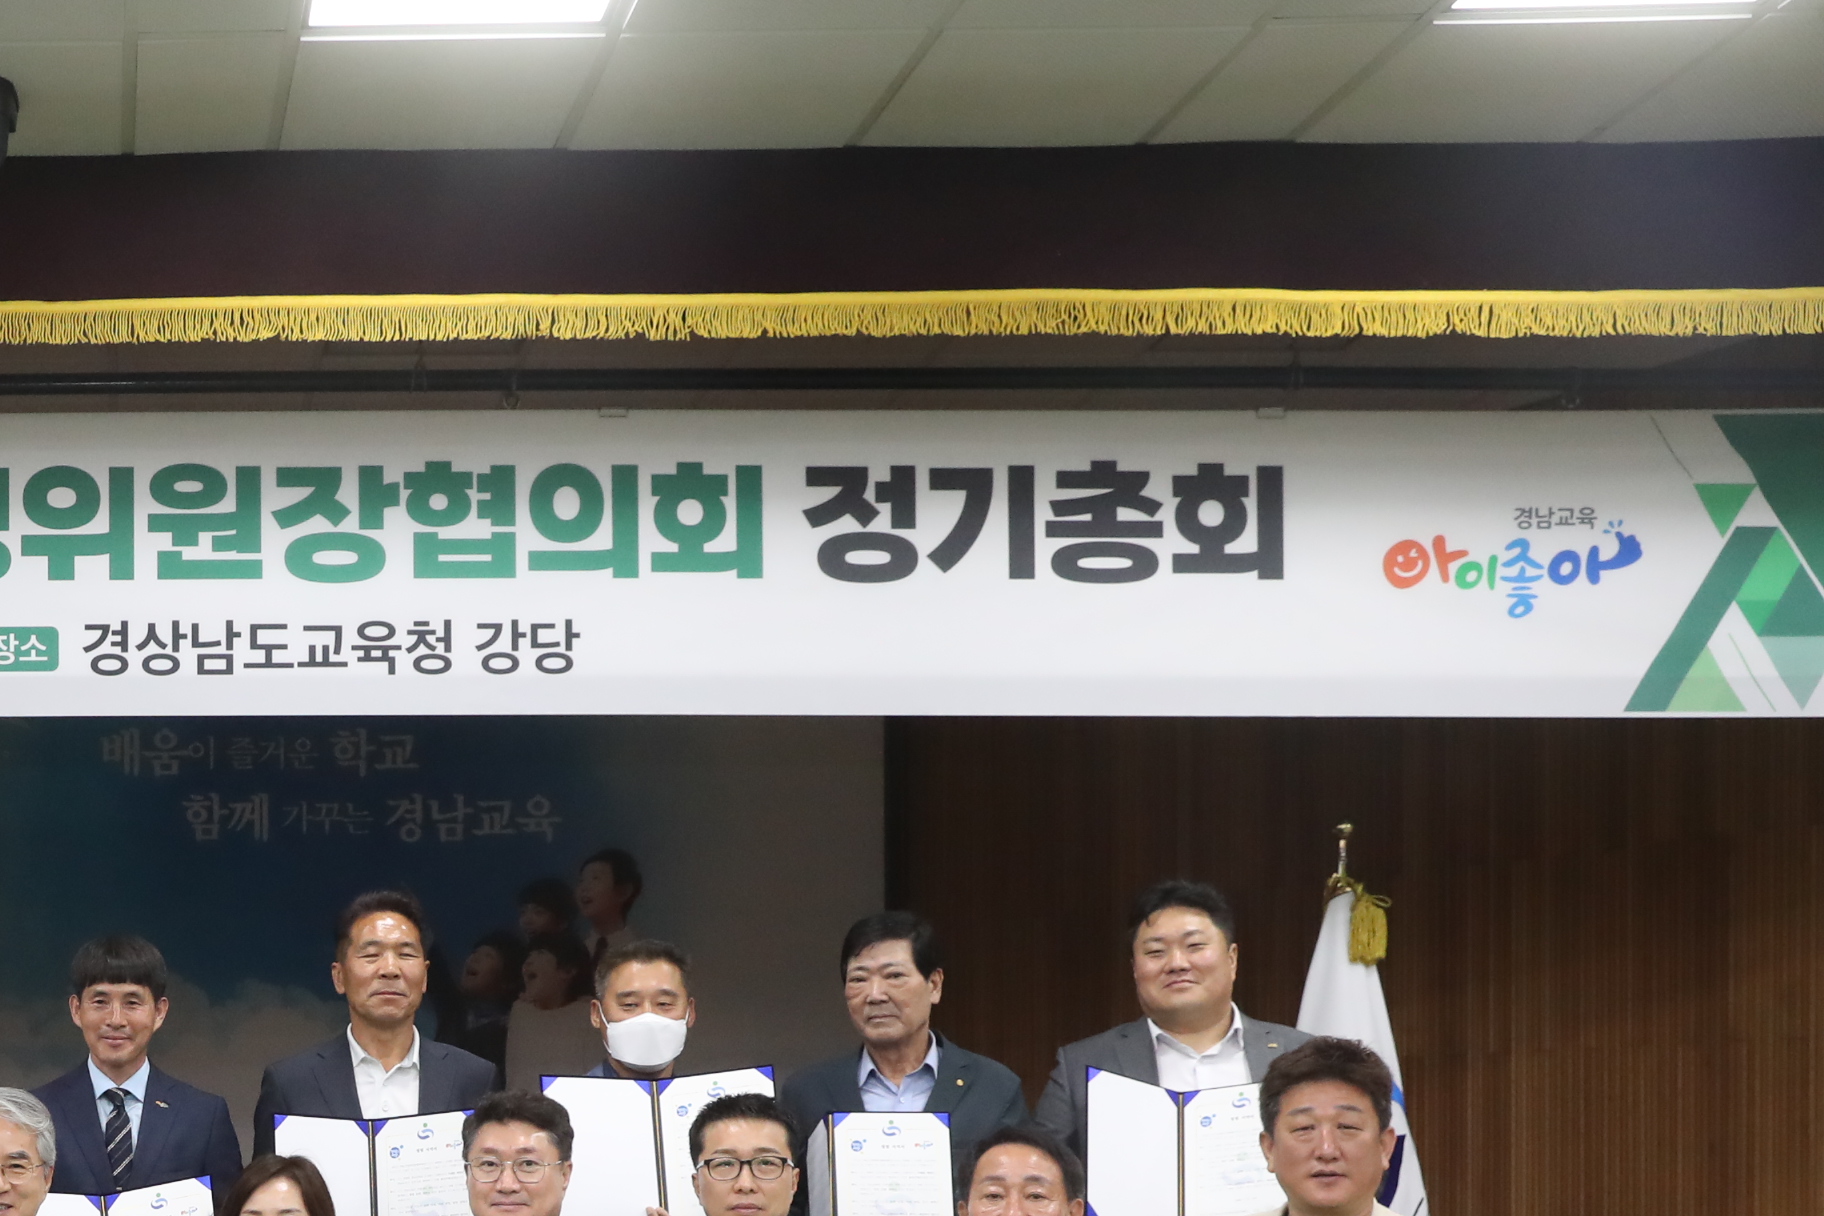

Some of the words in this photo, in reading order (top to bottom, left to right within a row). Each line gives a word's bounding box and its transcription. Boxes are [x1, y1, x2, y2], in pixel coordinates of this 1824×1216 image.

[802, 459, 1285, 584] 정기총회
[1513, 506, 1597, 530] 경남교육
[1382, 533, 1643, 618] 아이좋아
[82, 619, 453, 677] 경상남도교육청
[474, 618, 581, 675] 강당
[100, 727, 216, 777] 배움이
[225, 734, 319, 772] 즐거운
[329, 728, 420, 776] 학교
[182, 793, 270, 843] 함께
[281, 801, 374, 837] 가꾸는
[386, 793, 562, 843] 경남교육
